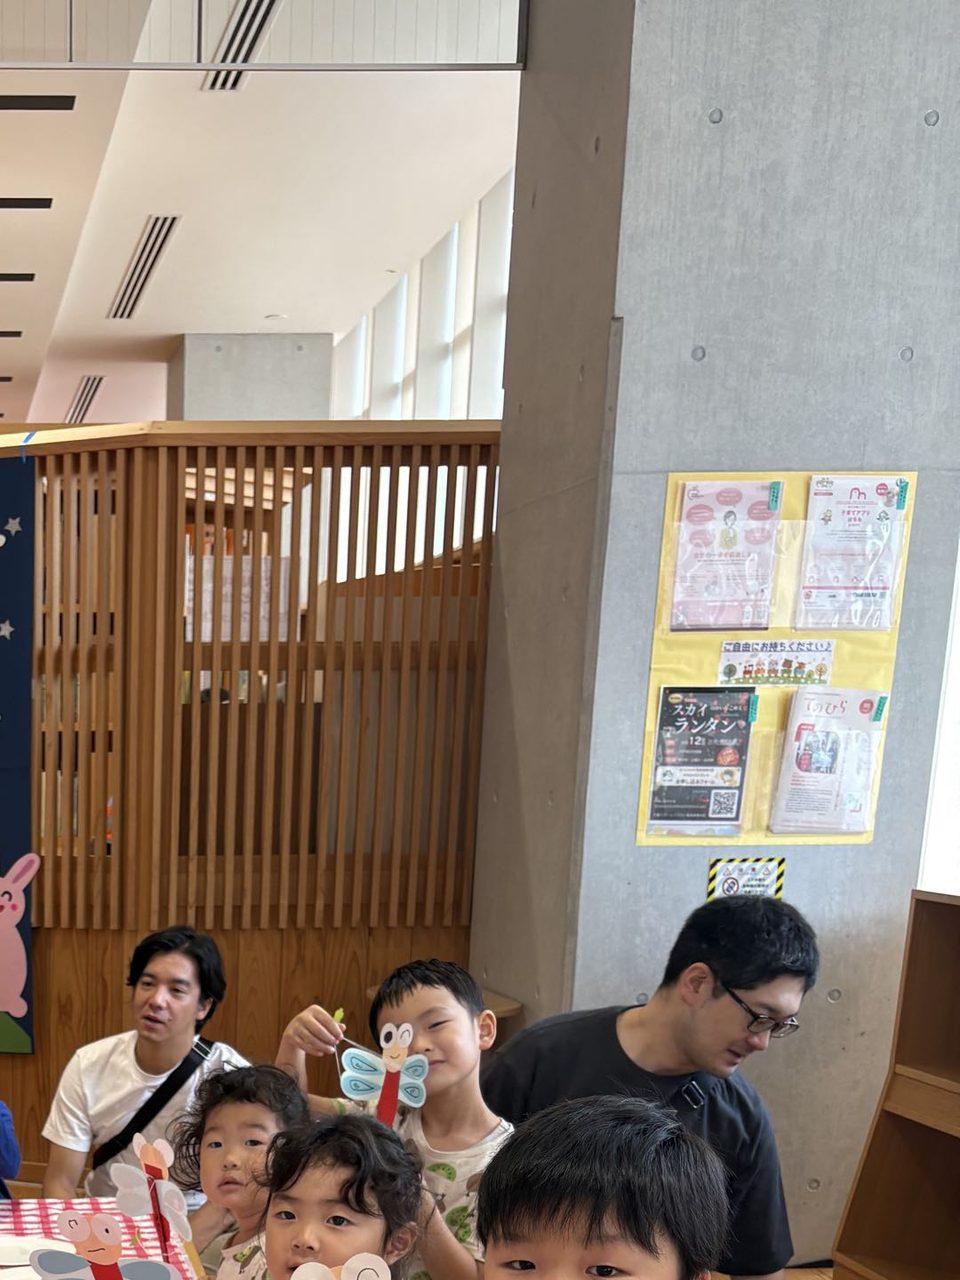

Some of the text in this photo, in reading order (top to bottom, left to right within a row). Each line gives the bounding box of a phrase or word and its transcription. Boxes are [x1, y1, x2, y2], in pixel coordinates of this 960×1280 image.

[672, 704, 708, 716] スカイ
[675, 717, 737, 734] ランタン
